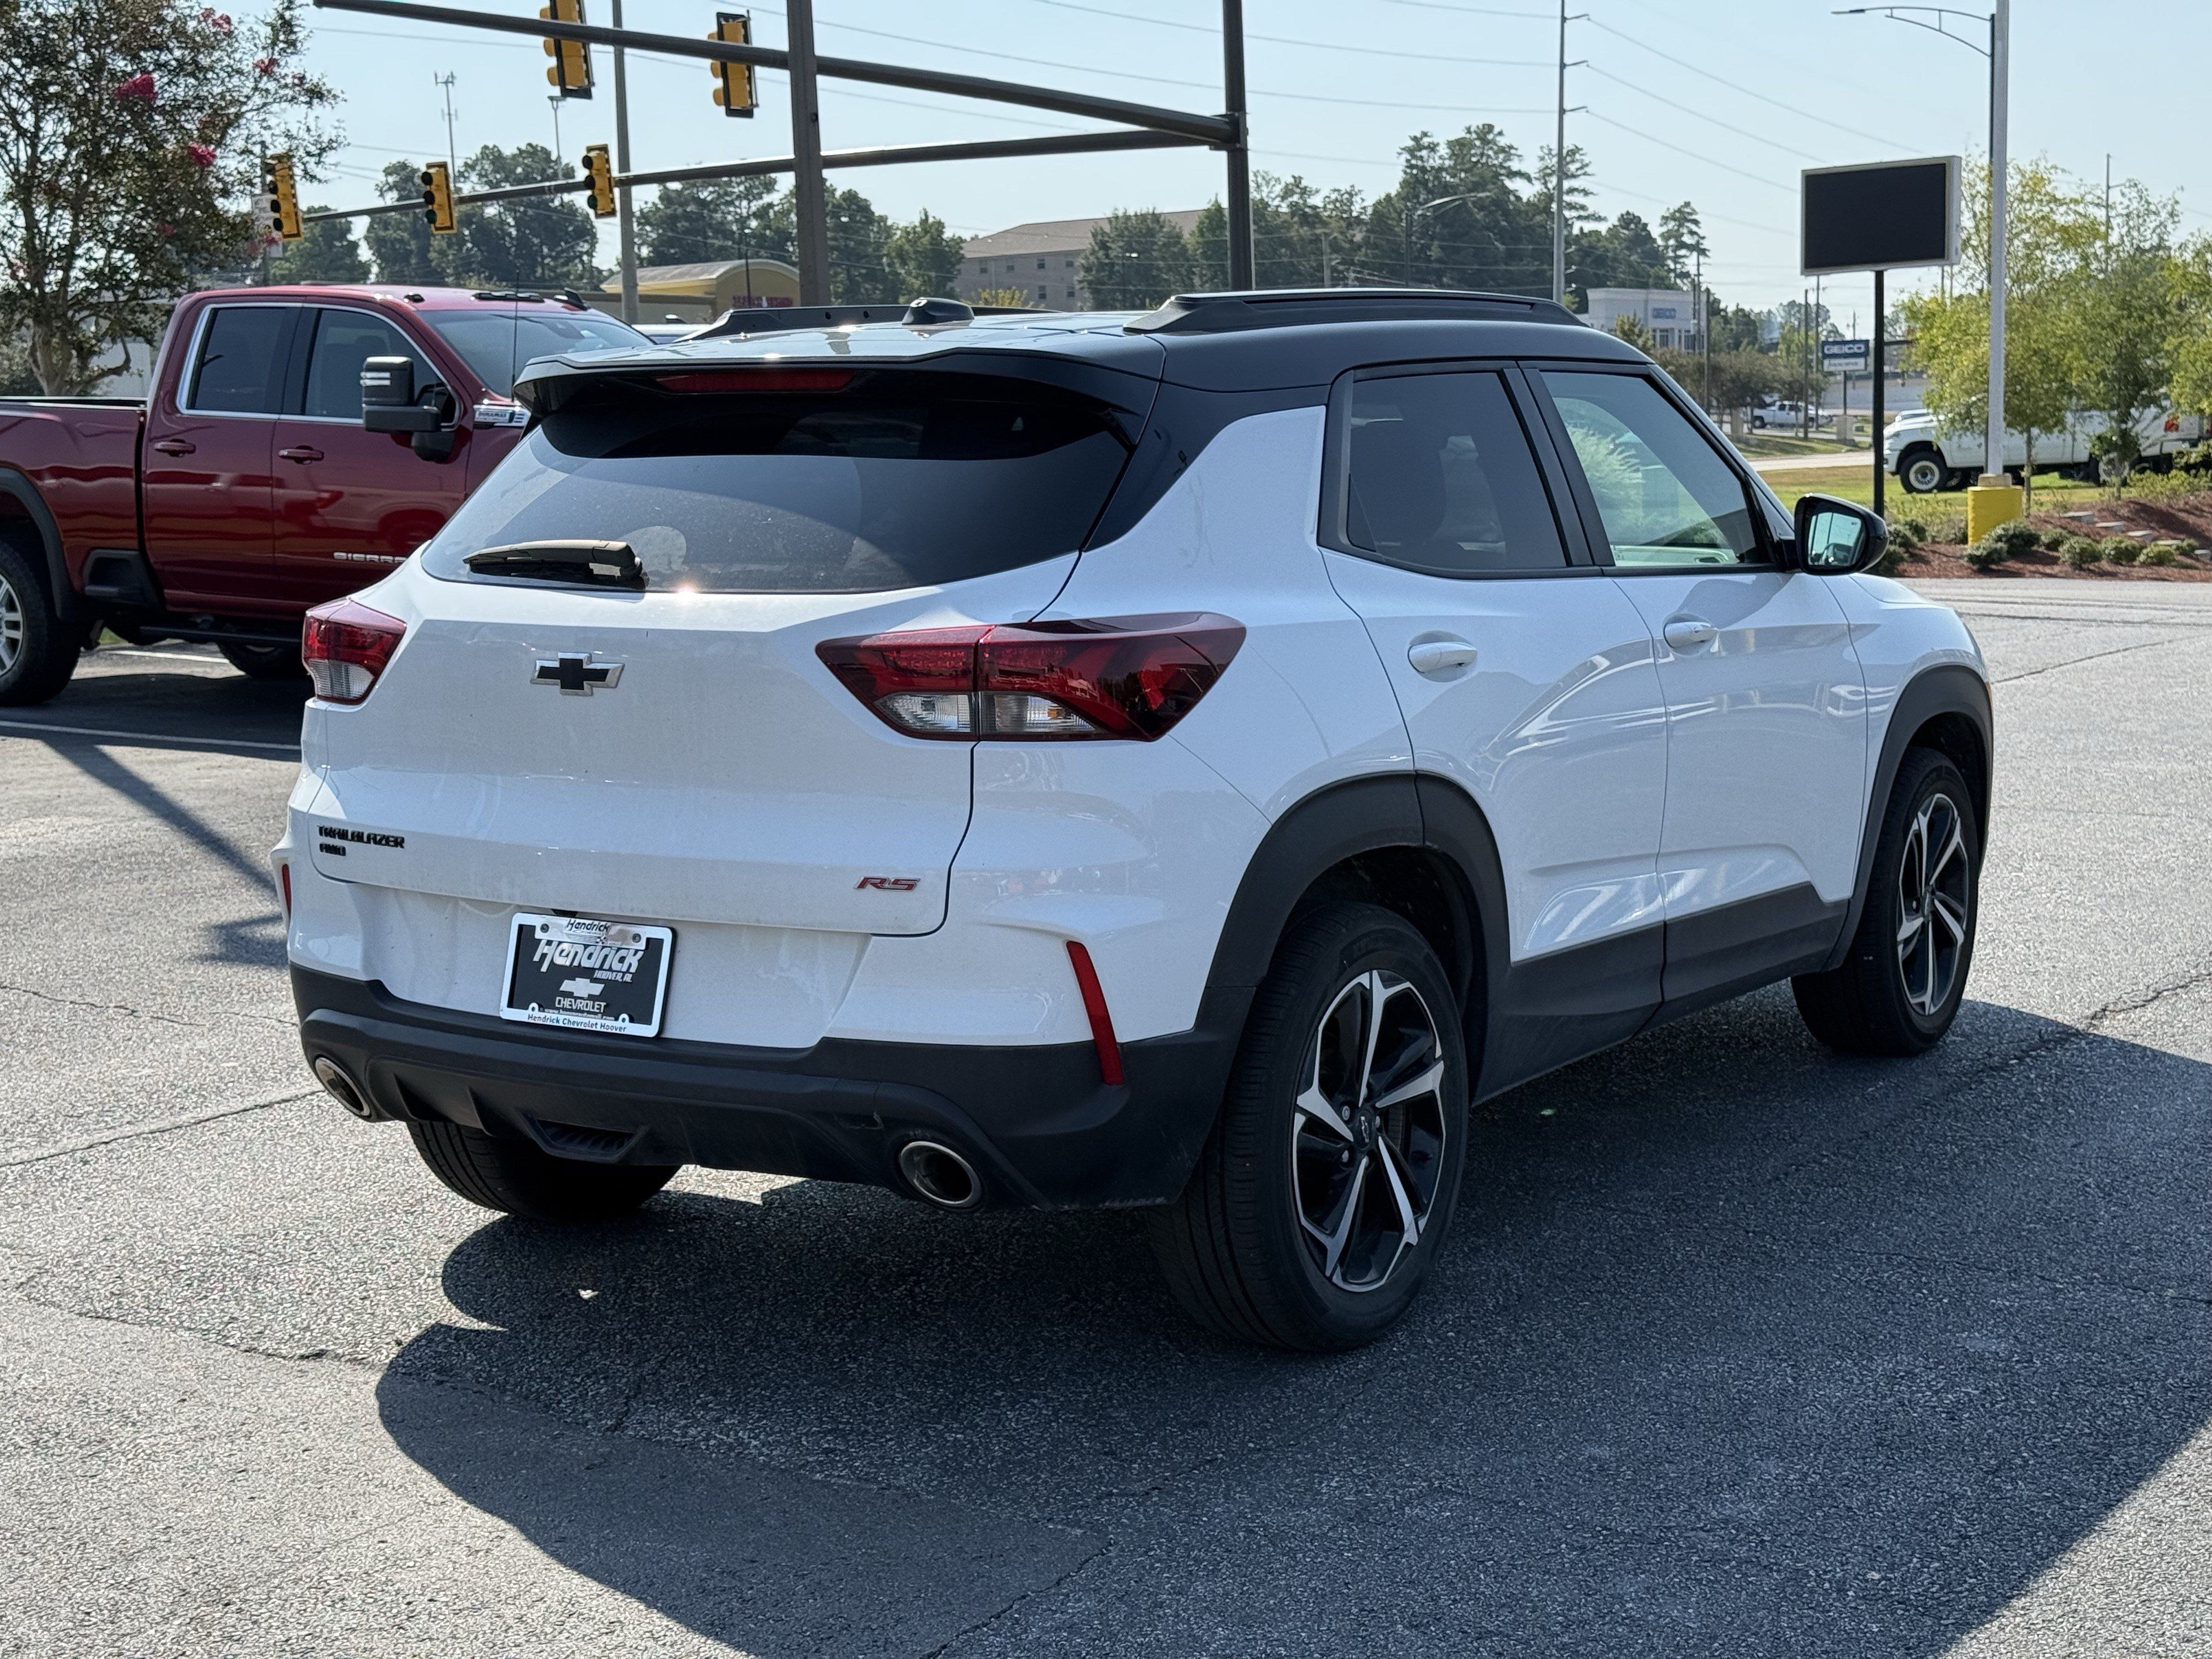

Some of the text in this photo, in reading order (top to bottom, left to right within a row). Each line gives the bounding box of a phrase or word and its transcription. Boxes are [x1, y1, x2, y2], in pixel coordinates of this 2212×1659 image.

[1824, 343, 1865, 354] GEICO
[317, 825, 405, 849] TRAILBLAZER
[854, 875, 921, 892] RS
[566, 918, 610, 932] Hendrick
[533, 939, 645, 973] Hendrick
[623, 973, 633, 983] AL
[555, 997, 607, 1013] CHEVROLET
[527, 1014, 627, 1032] Hendrick Chevrolet Hoover
